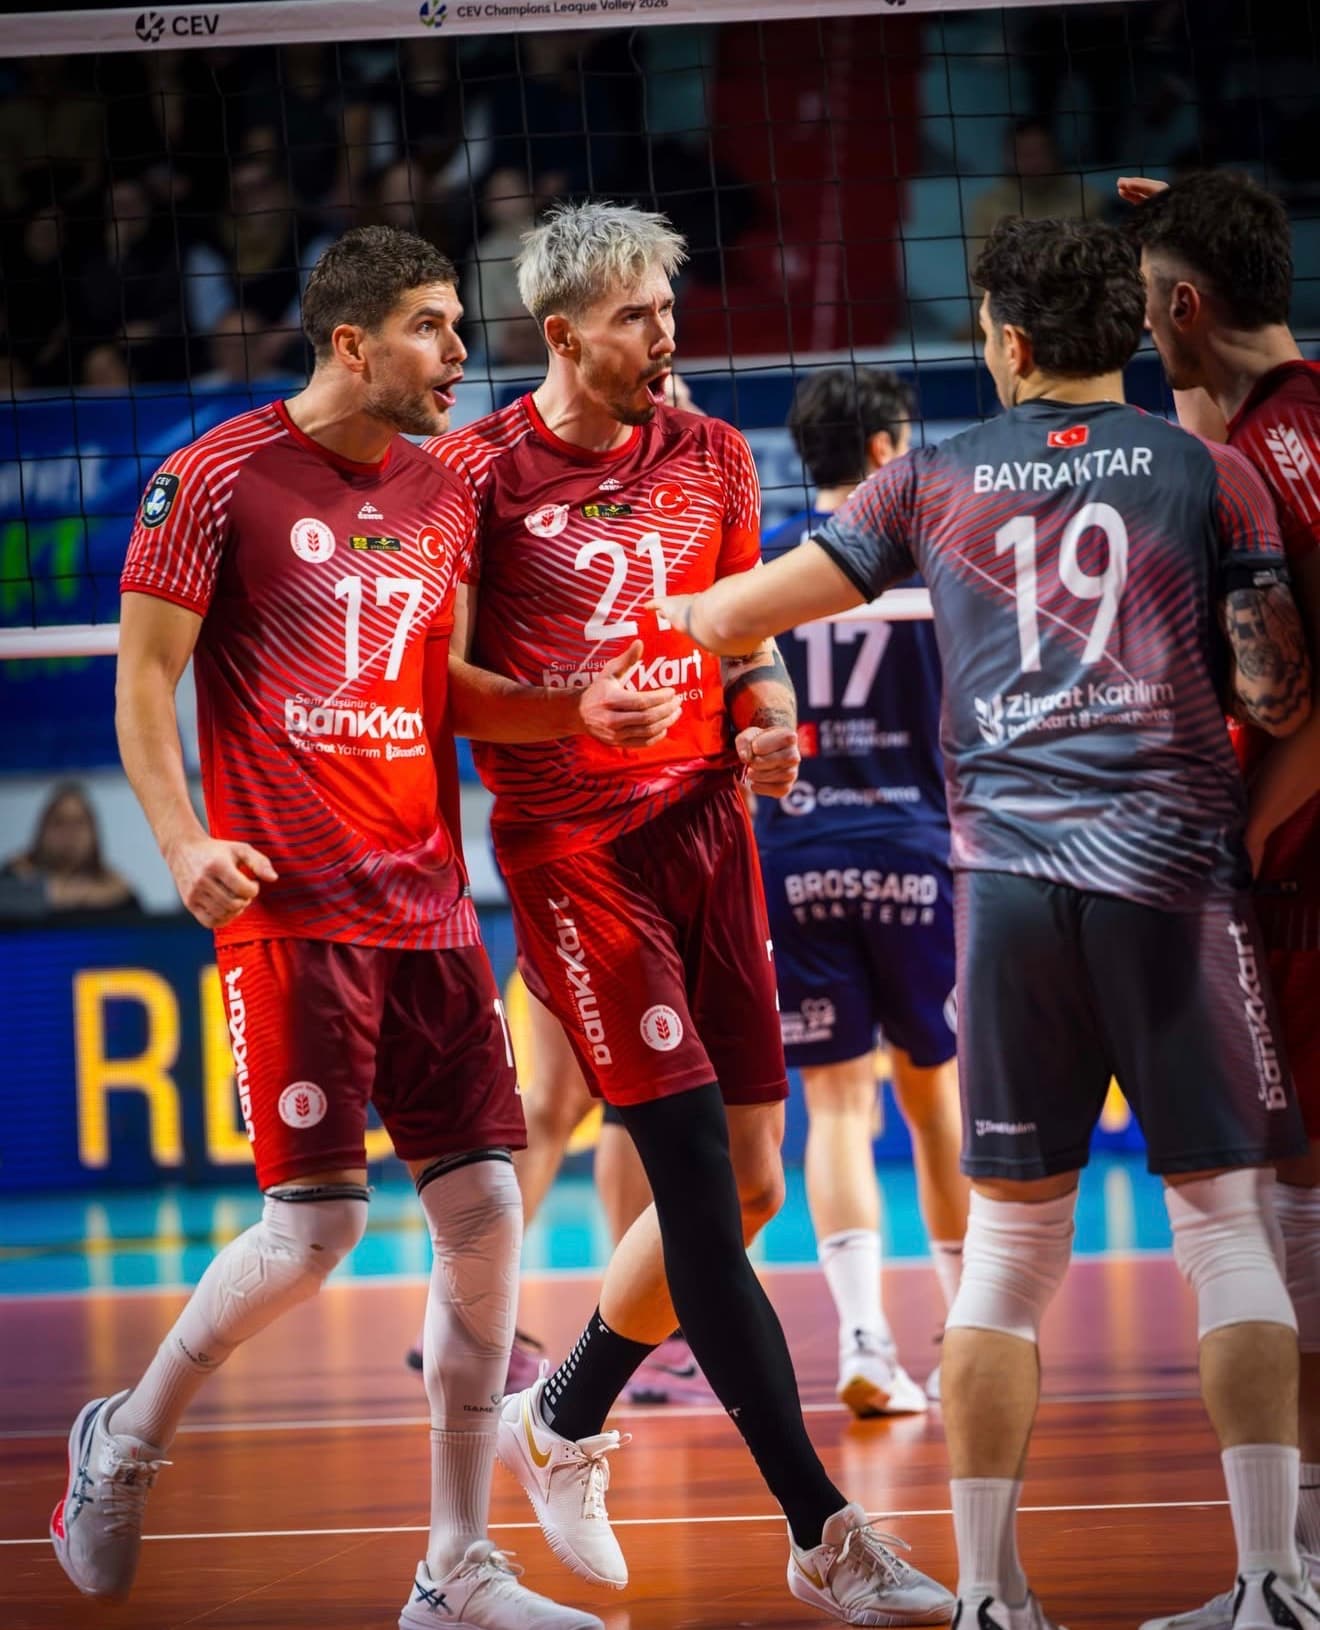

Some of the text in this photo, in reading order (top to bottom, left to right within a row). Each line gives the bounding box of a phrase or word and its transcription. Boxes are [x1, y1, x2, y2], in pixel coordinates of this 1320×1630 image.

[172, 15, 219, 37] CEV
[457, 5, 481, 17] CEV
[486, 2, 550, 18] Champions
[554, 0, 597, 13] League
[973, 447, 1153, 493] BAYRAKTAR
[574, 531, 671, 641] 21
[994, 502, 1130, 673] 19
[334, 575, 423, 681] 17
[794, 620, 892, 708] 17
[785, 868, 938, 905] BROSSARD
